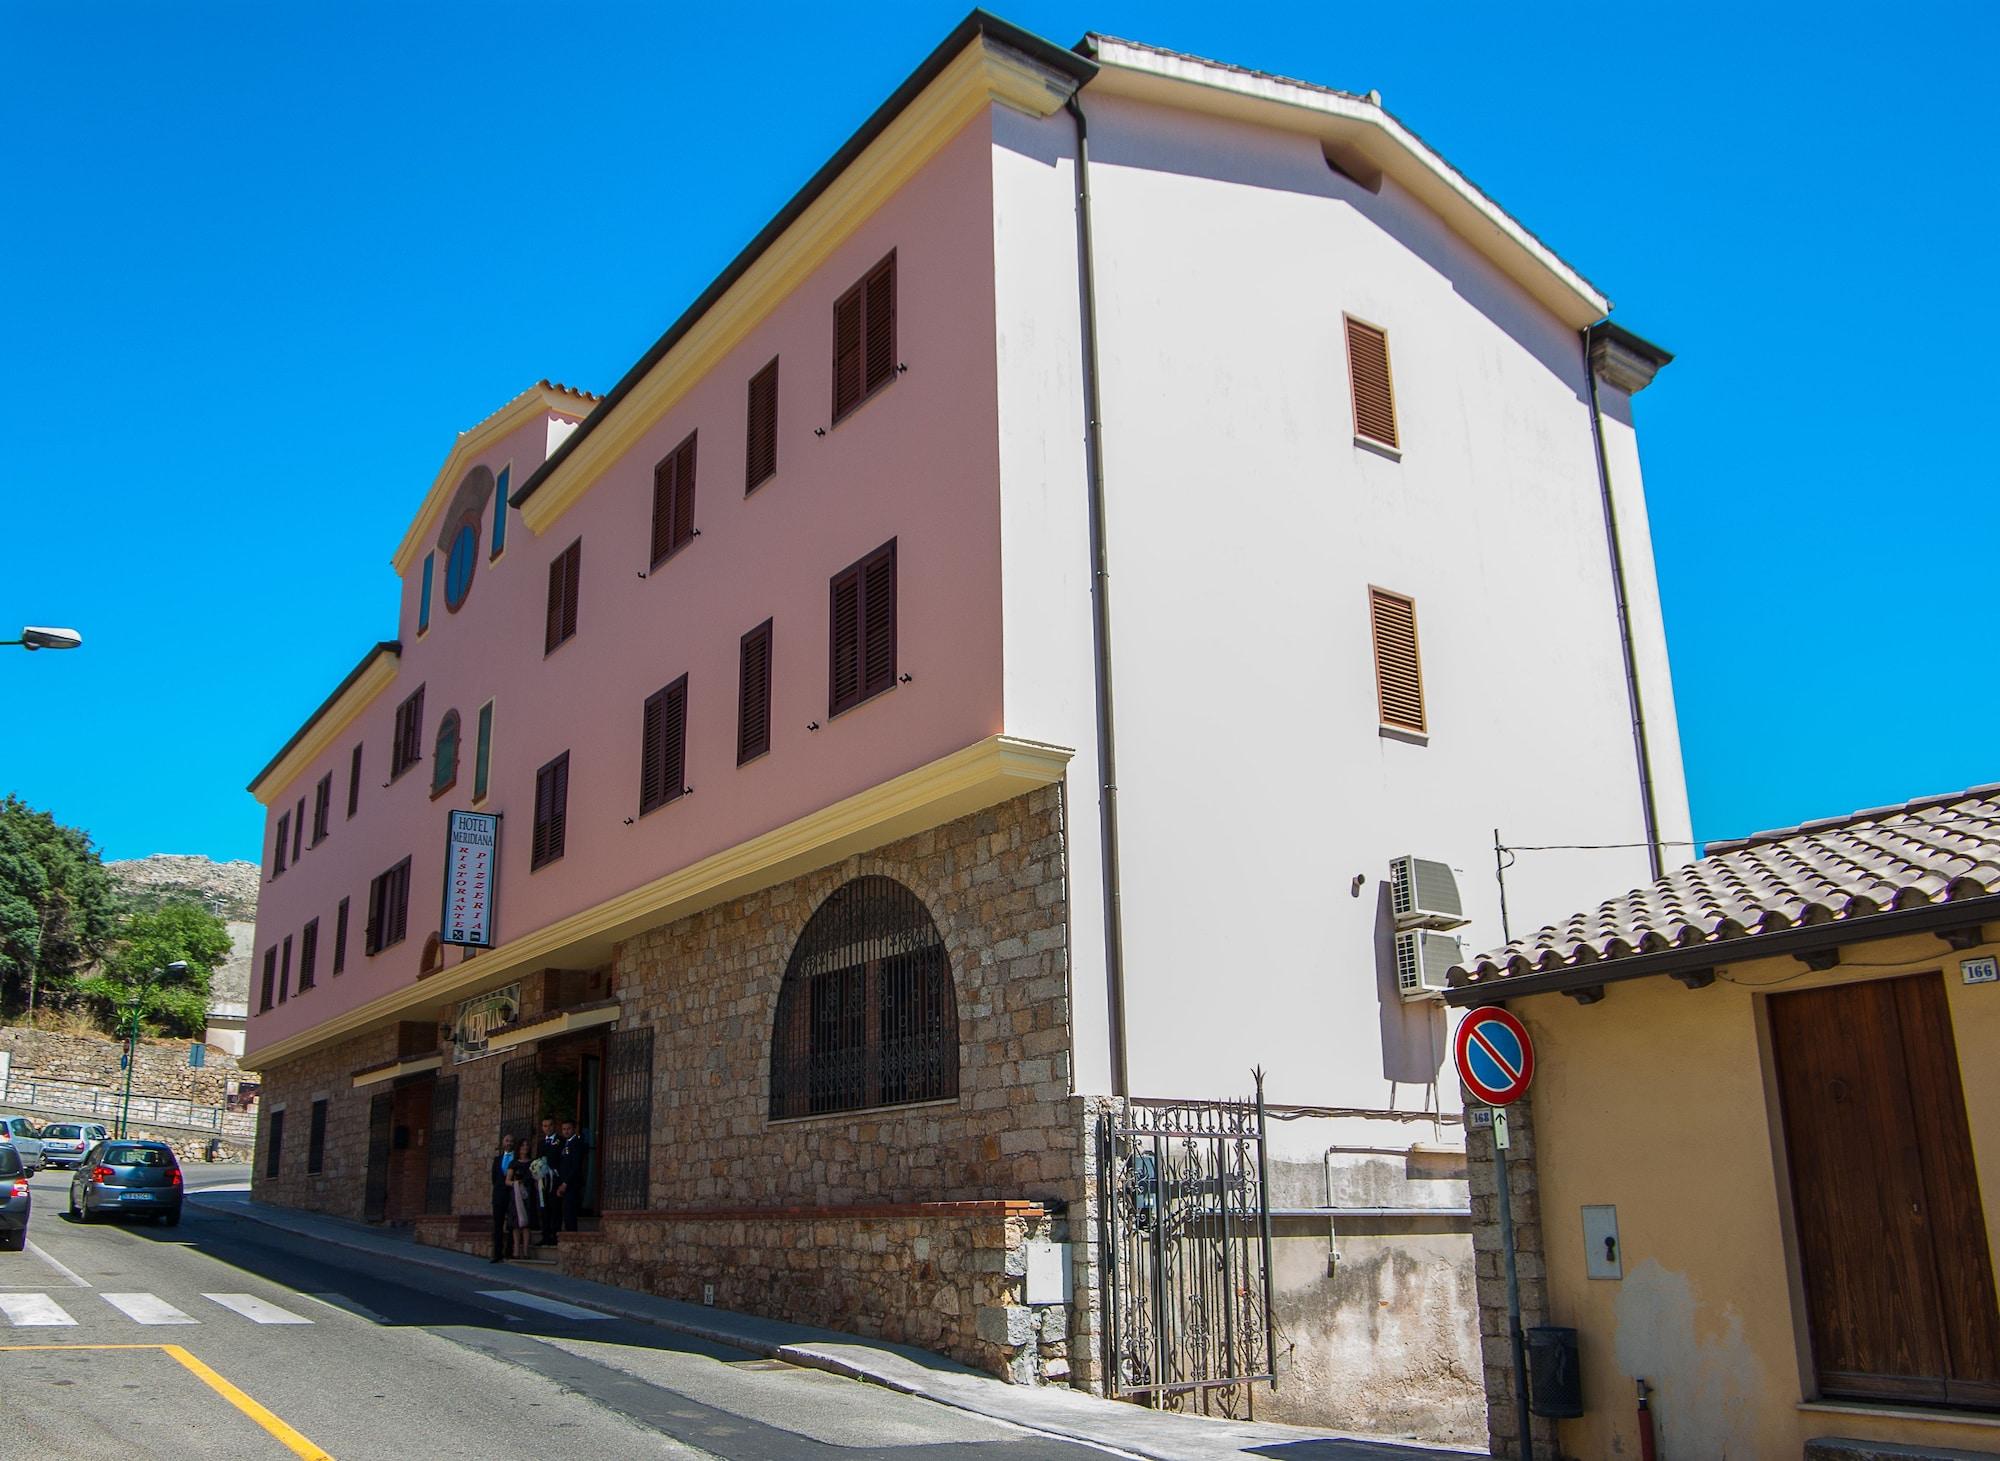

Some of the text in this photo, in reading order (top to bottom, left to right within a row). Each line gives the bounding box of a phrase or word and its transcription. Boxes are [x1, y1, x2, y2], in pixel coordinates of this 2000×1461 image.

[458, 816, 489, 833] HOTEL
[453, 831, 493, 846] MERIDIANA
[454, 847, 469, 928] RISTORANTE
[472, 852, 487, 930] PIZZERIA
[1968, 964, 1993, 979] 166
[1474, 1112, 1490, 1123] 168
